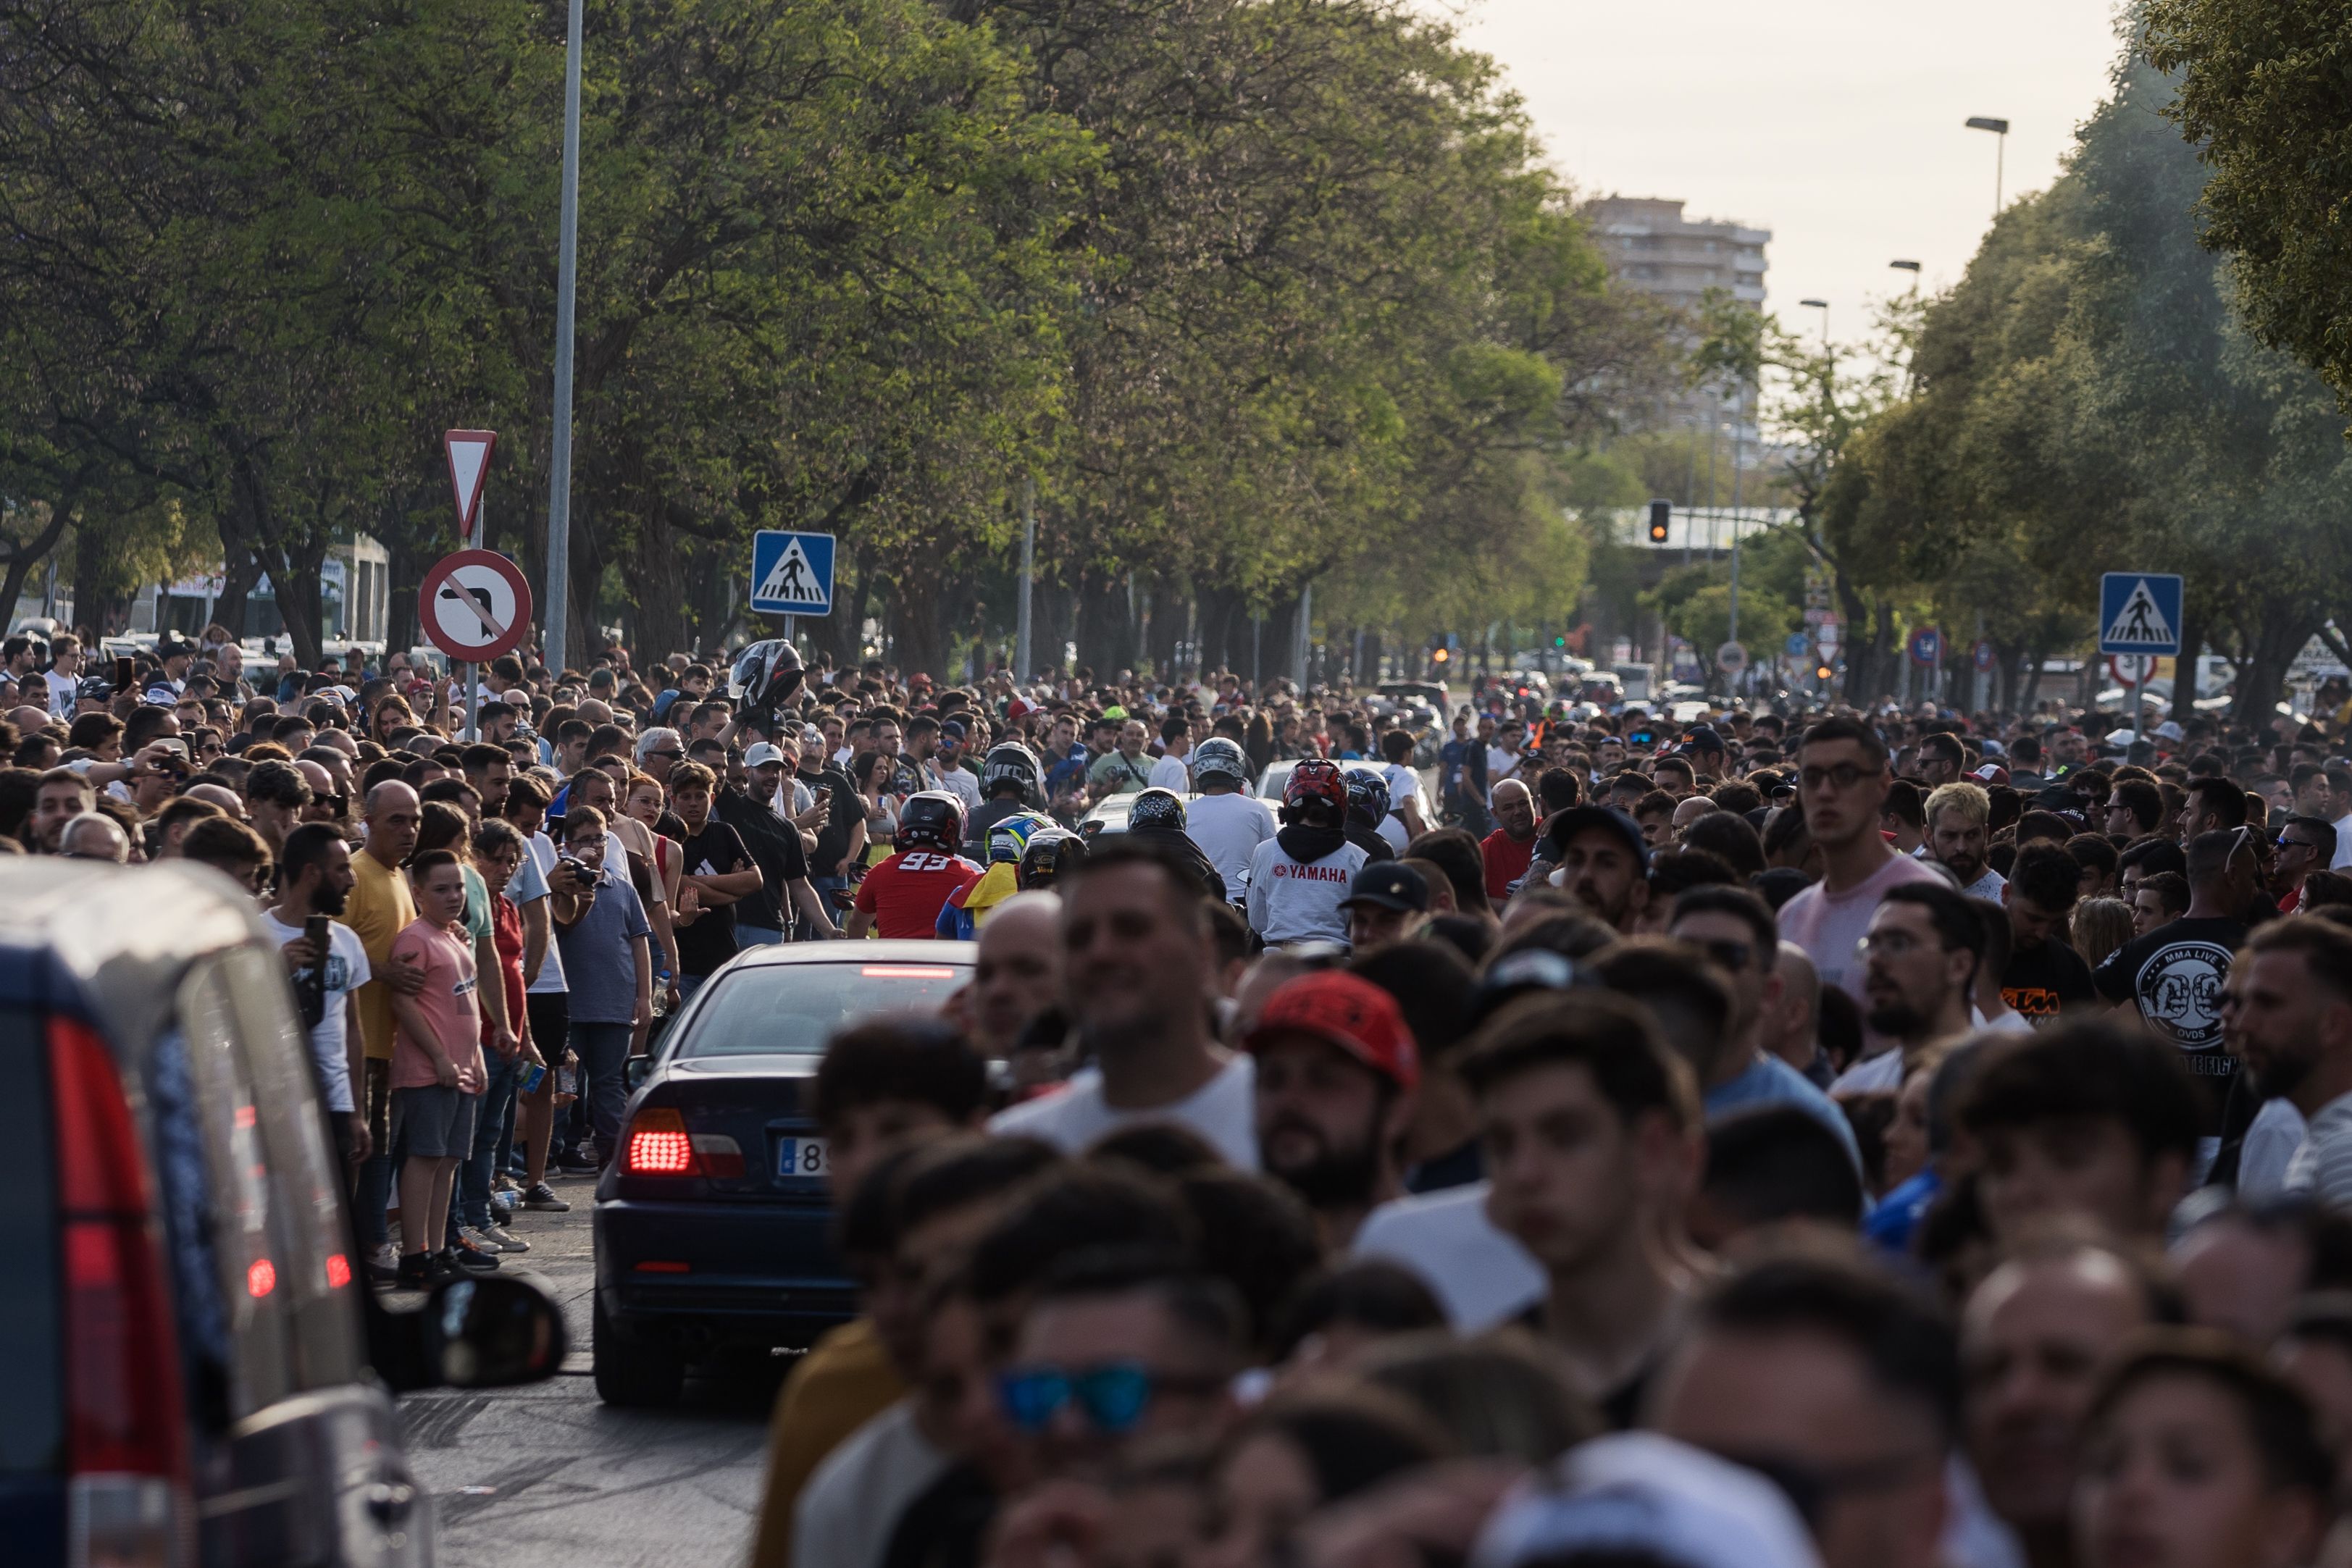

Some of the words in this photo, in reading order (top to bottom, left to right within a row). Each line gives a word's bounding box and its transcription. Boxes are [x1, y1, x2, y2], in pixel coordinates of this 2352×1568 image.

[898, 852, 952, 871] 93
[1289, 864, 1347, 884] YAMAHA
[2164, 950, 2192, 964] MMA
[2195, 950, 2219, 965] LIVE
[2177, 1028, 2206, 1039] OVDS
